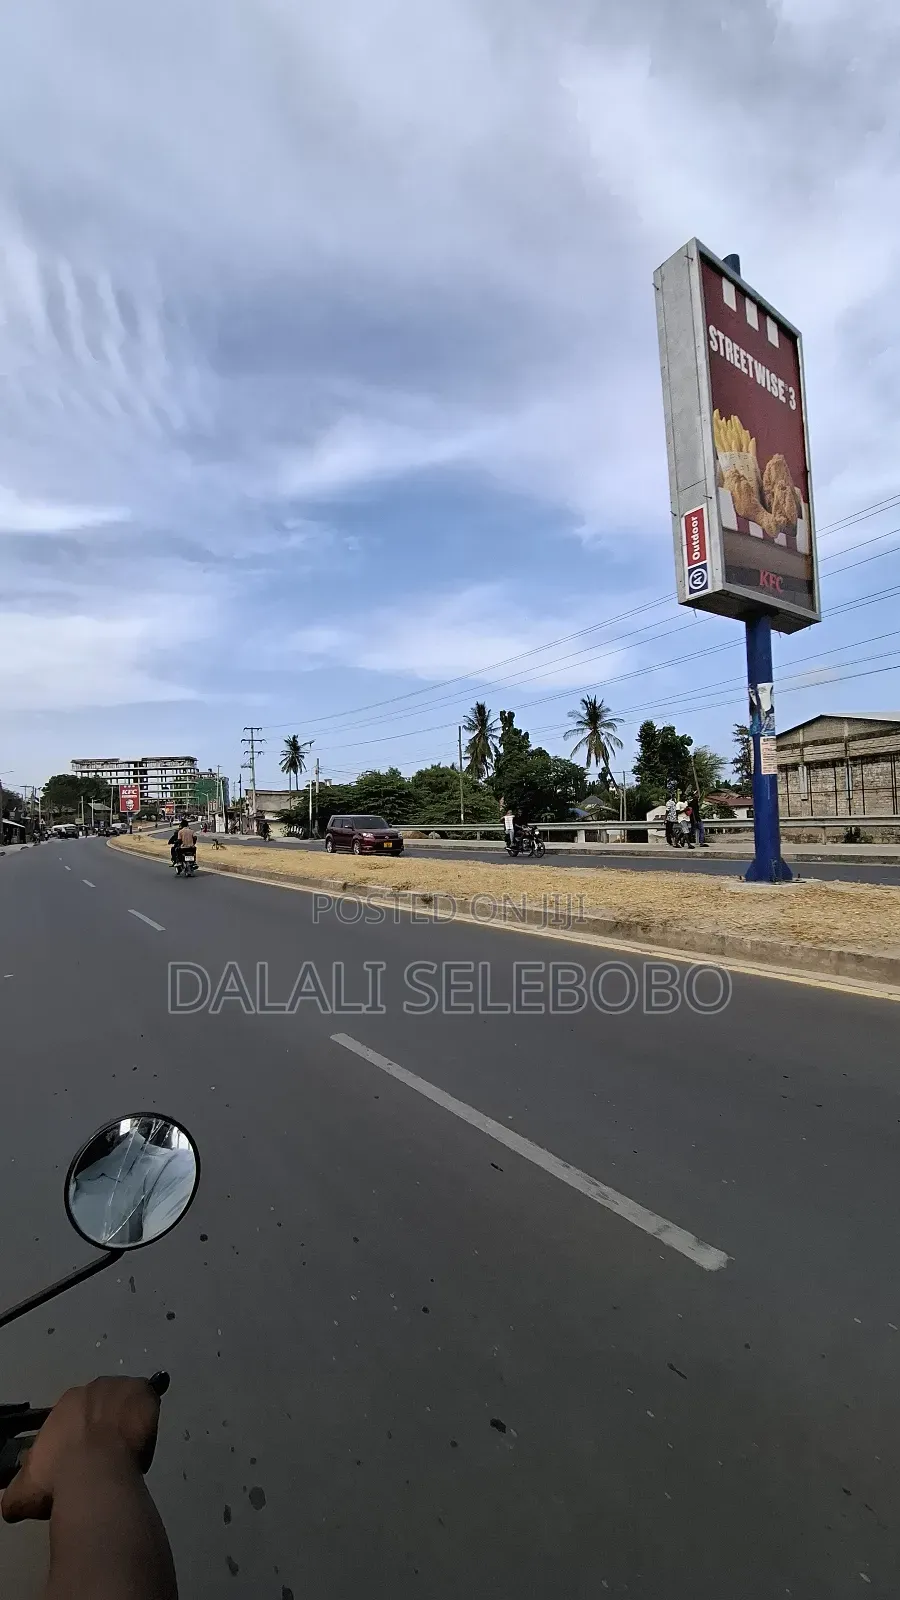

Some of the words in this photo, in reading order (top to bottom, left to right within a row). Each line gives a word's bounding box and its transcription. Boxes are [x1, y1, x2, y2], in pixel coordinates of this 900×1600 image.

[788, 386, 797, 411] 3
[691, 515, 701, 561] Outdoor
[759, 569, 785, 593] KFC
